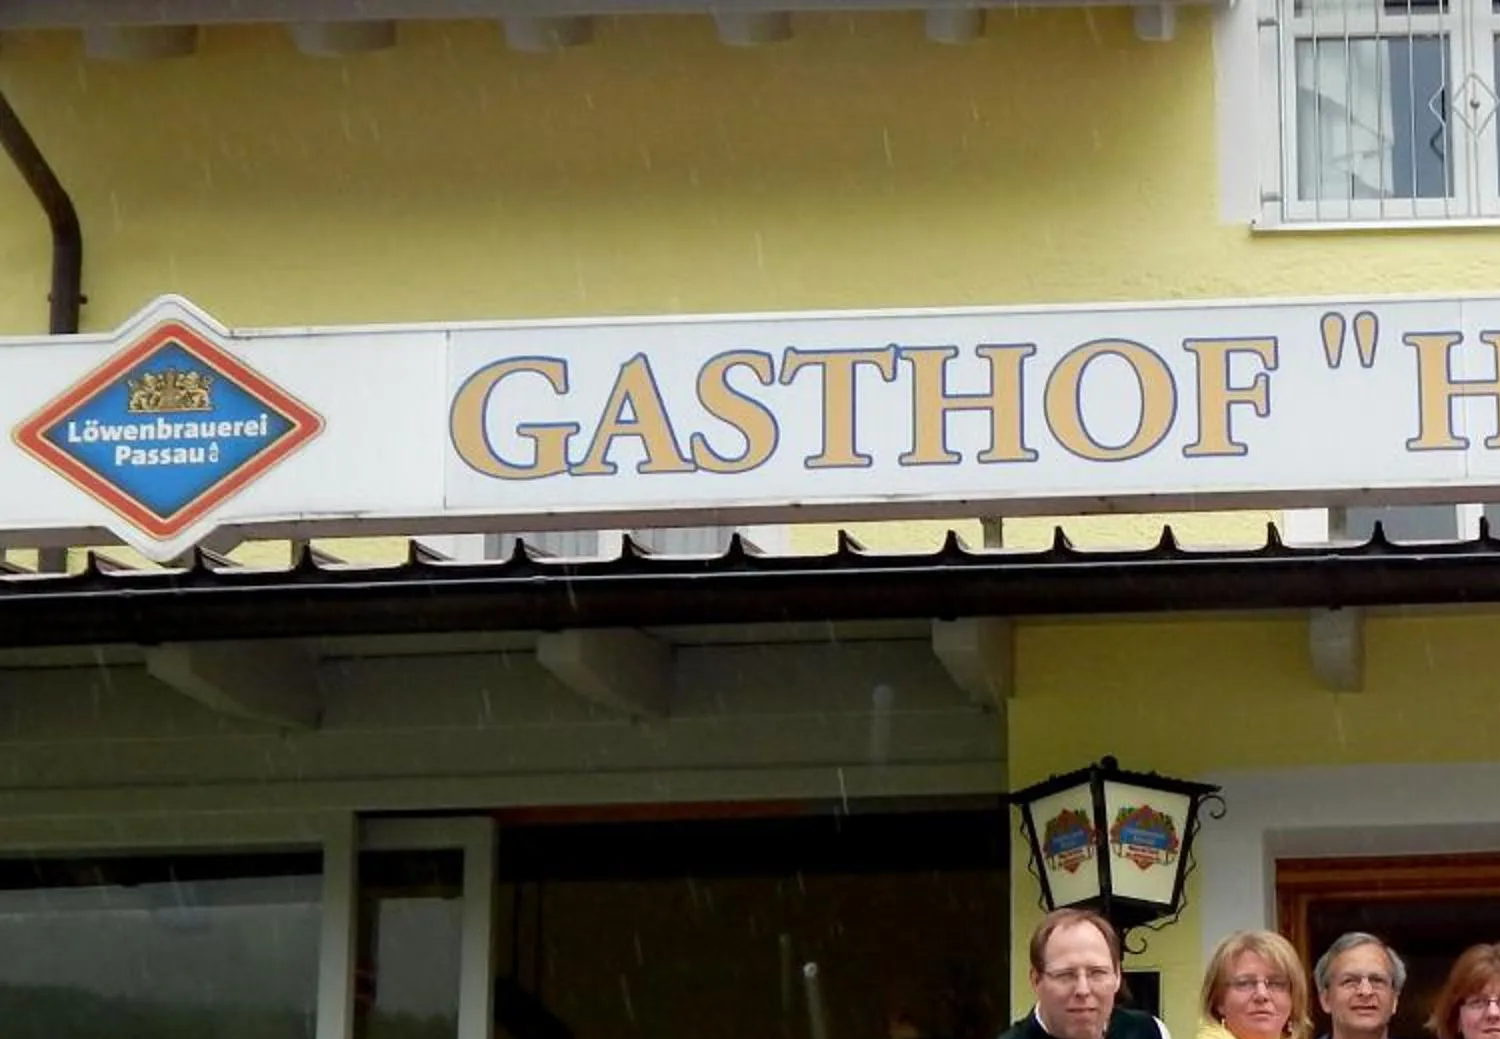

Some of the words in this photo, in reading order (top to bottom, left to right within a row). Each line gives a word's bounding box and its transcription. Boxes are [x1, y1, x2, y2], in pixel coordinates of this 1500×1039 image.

[449, 336, 1279, 480] GASTHOF
[68, 414, 268, 443] Löwenbrauerei
[115, 445, 205, 466] Passau
